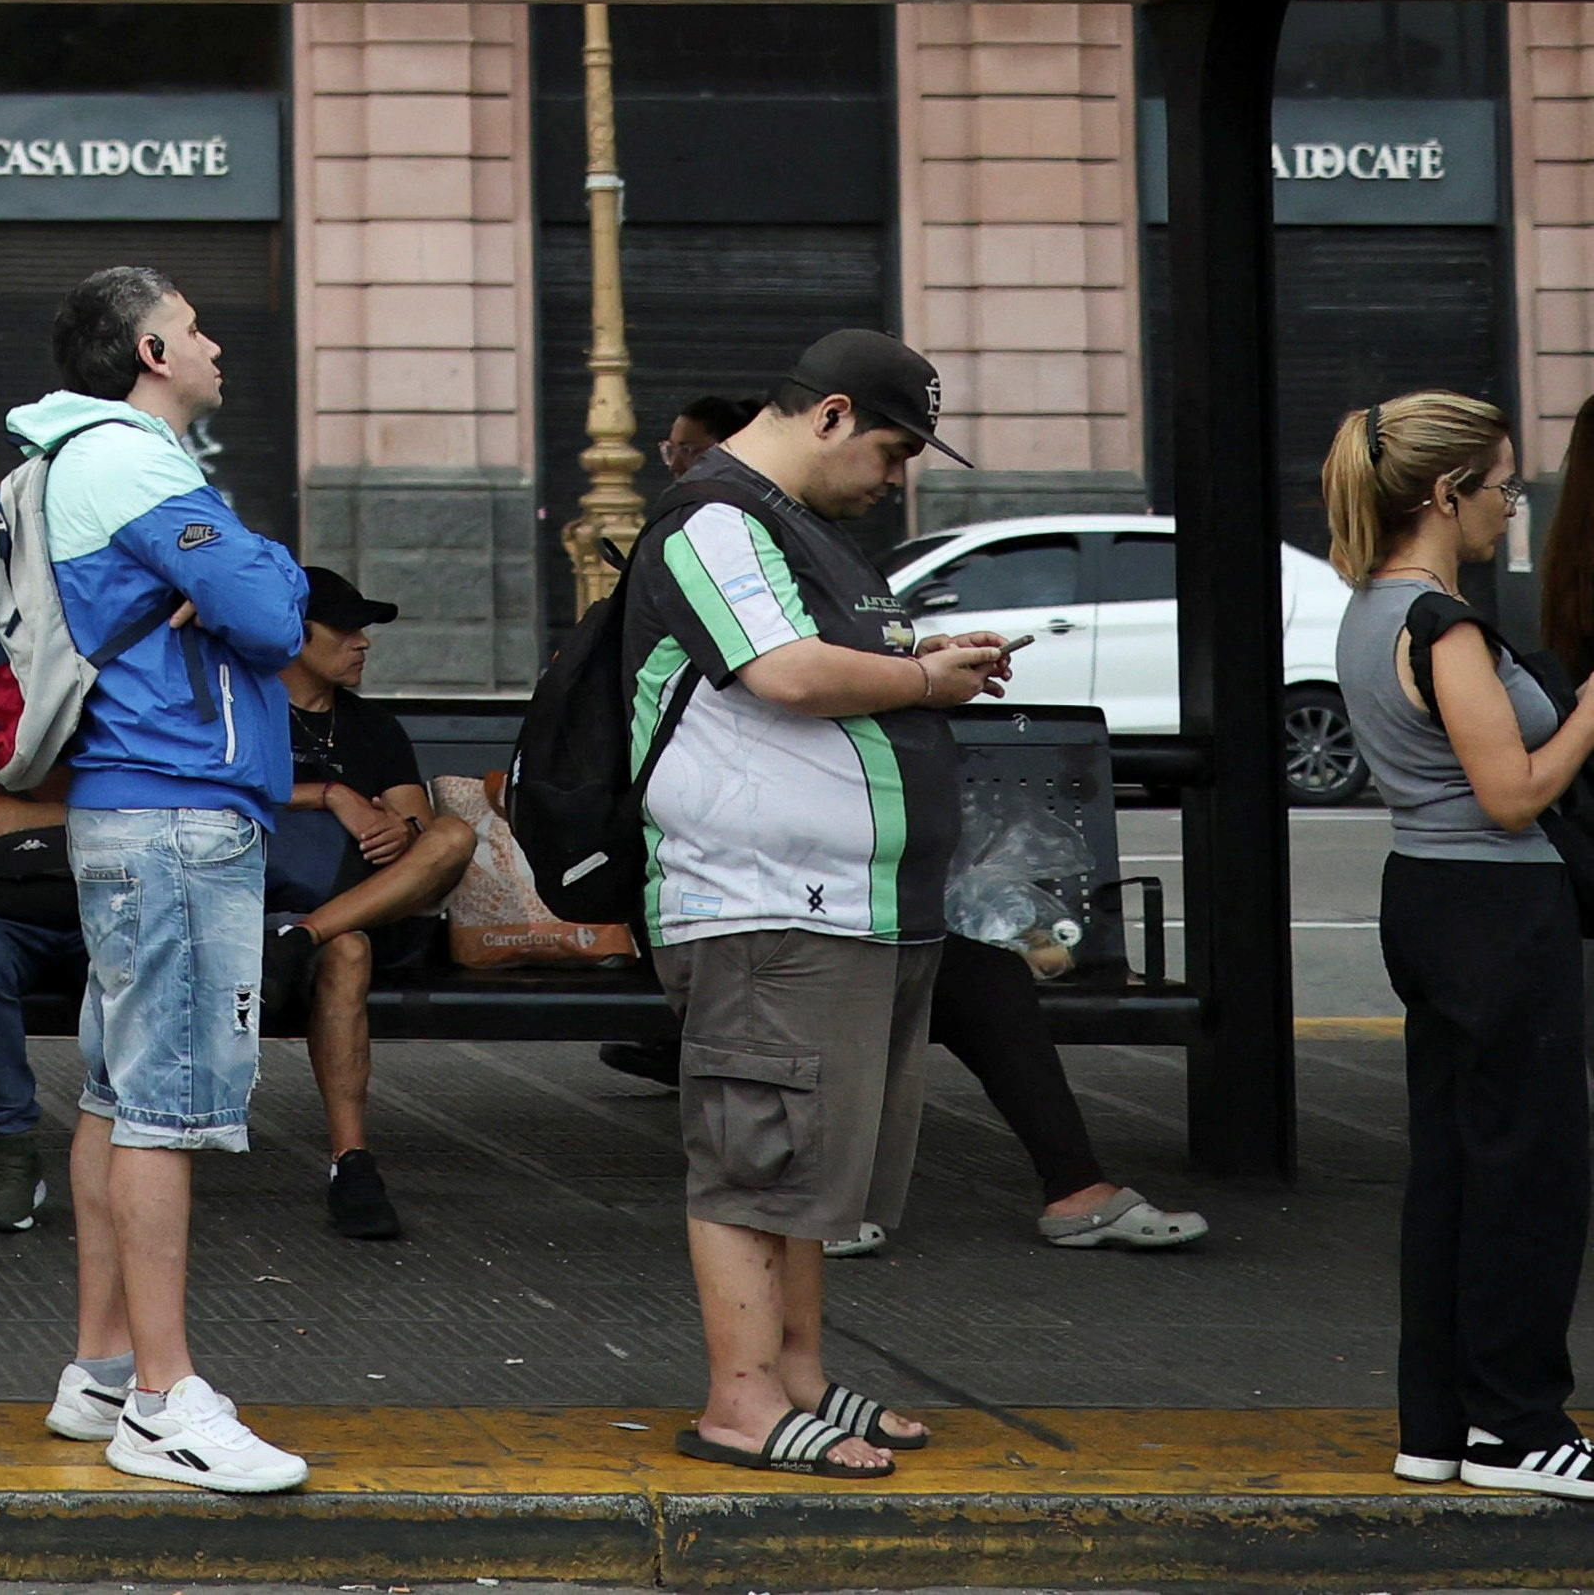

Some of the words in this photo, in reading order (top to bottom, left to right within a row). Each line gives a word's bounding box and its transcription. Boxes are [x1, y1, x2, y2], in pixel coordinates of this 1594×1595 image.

[132, 134, 229, 176] CAFÉ
[1348, 137, 1446, 181] CAFÉ
[184, 525, 213, 540] NIKE
[482, 930, 563, 947] Carrefour
